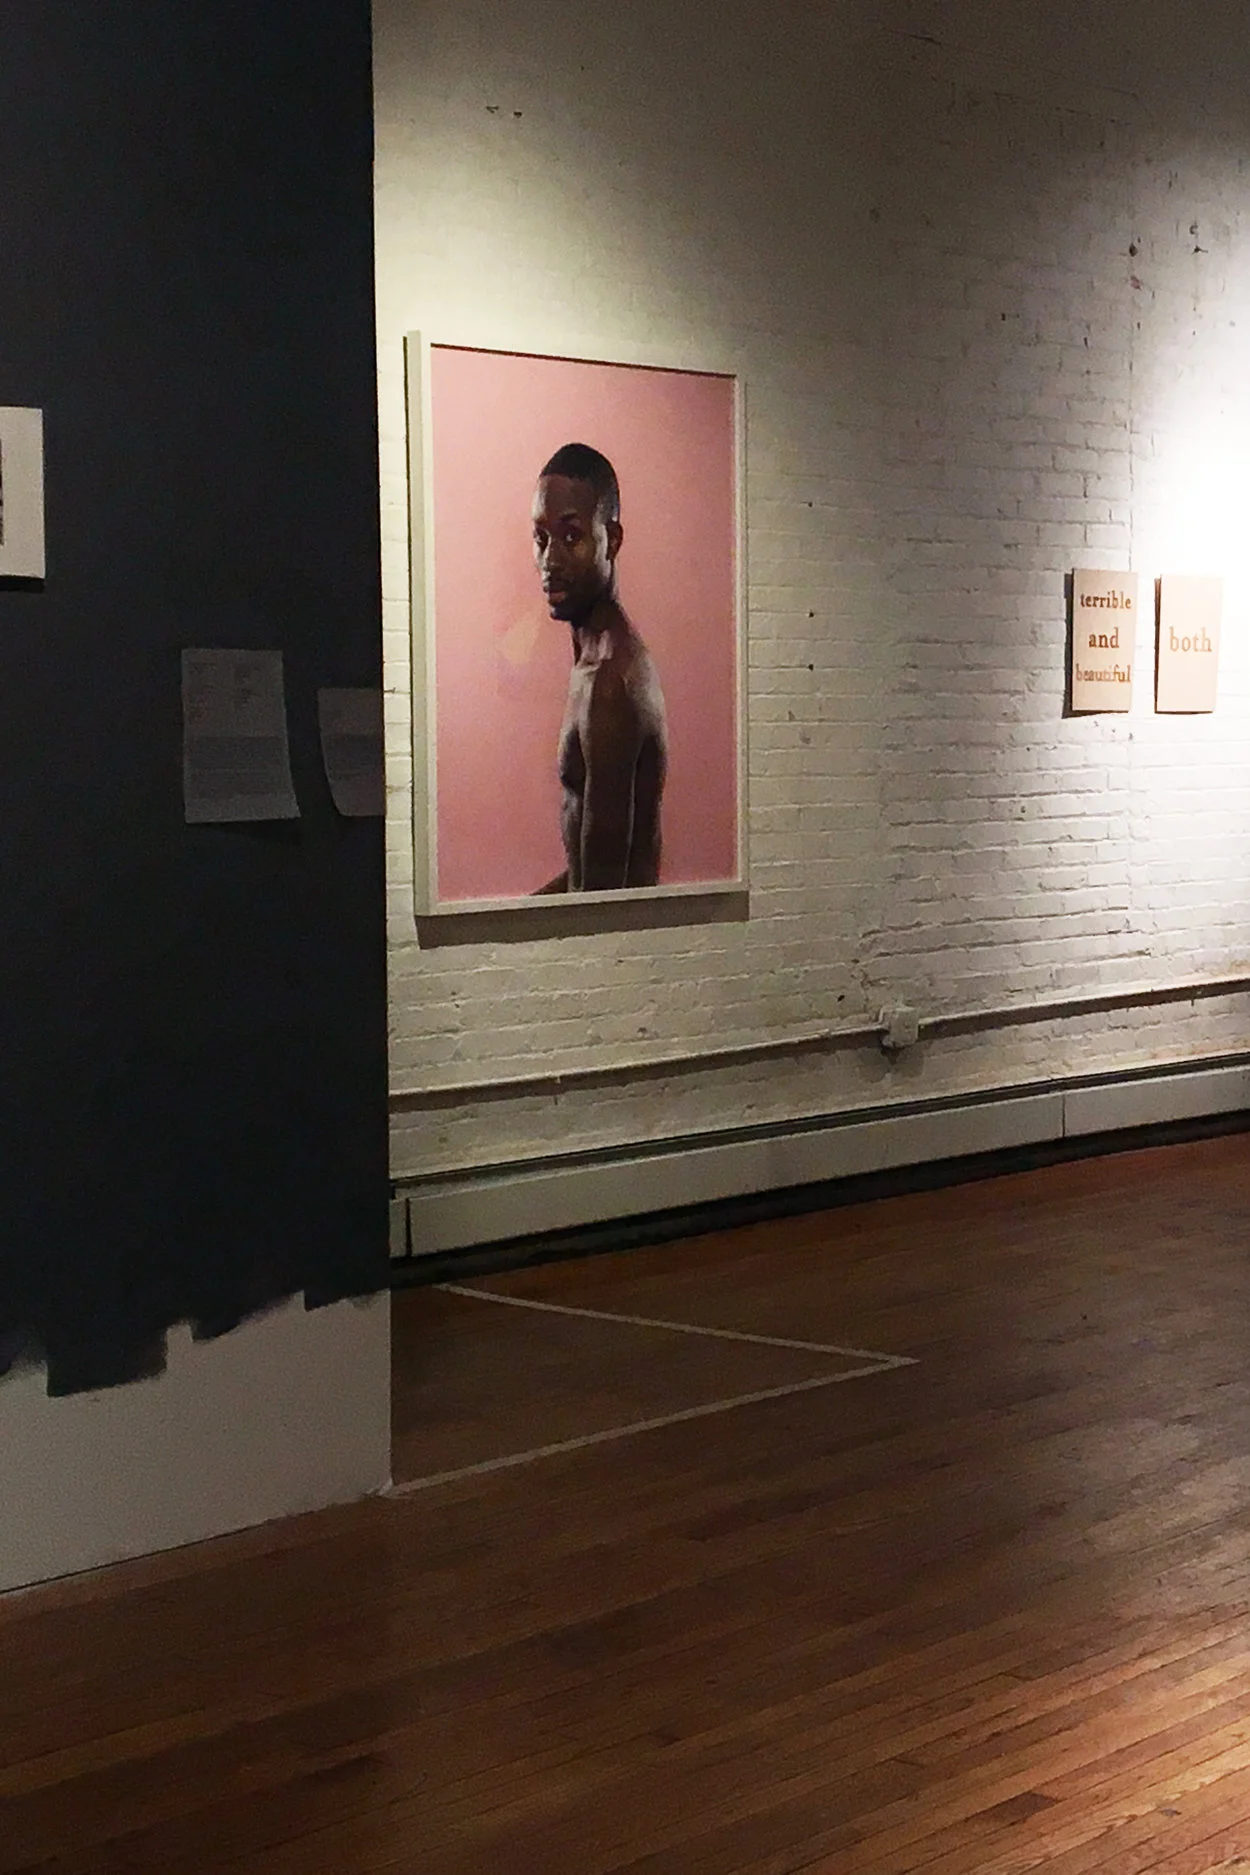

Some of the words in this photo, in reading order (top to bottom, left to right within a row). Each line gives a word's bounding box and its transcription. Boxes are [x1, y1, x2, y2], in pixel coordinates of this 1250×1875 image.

[1080, 590, 1132, 609] terrible
[1088, 627, 1120, 649] and
[1168, 627, 1213, 652] both
[1075, 664, 1132, 683] beautiful
